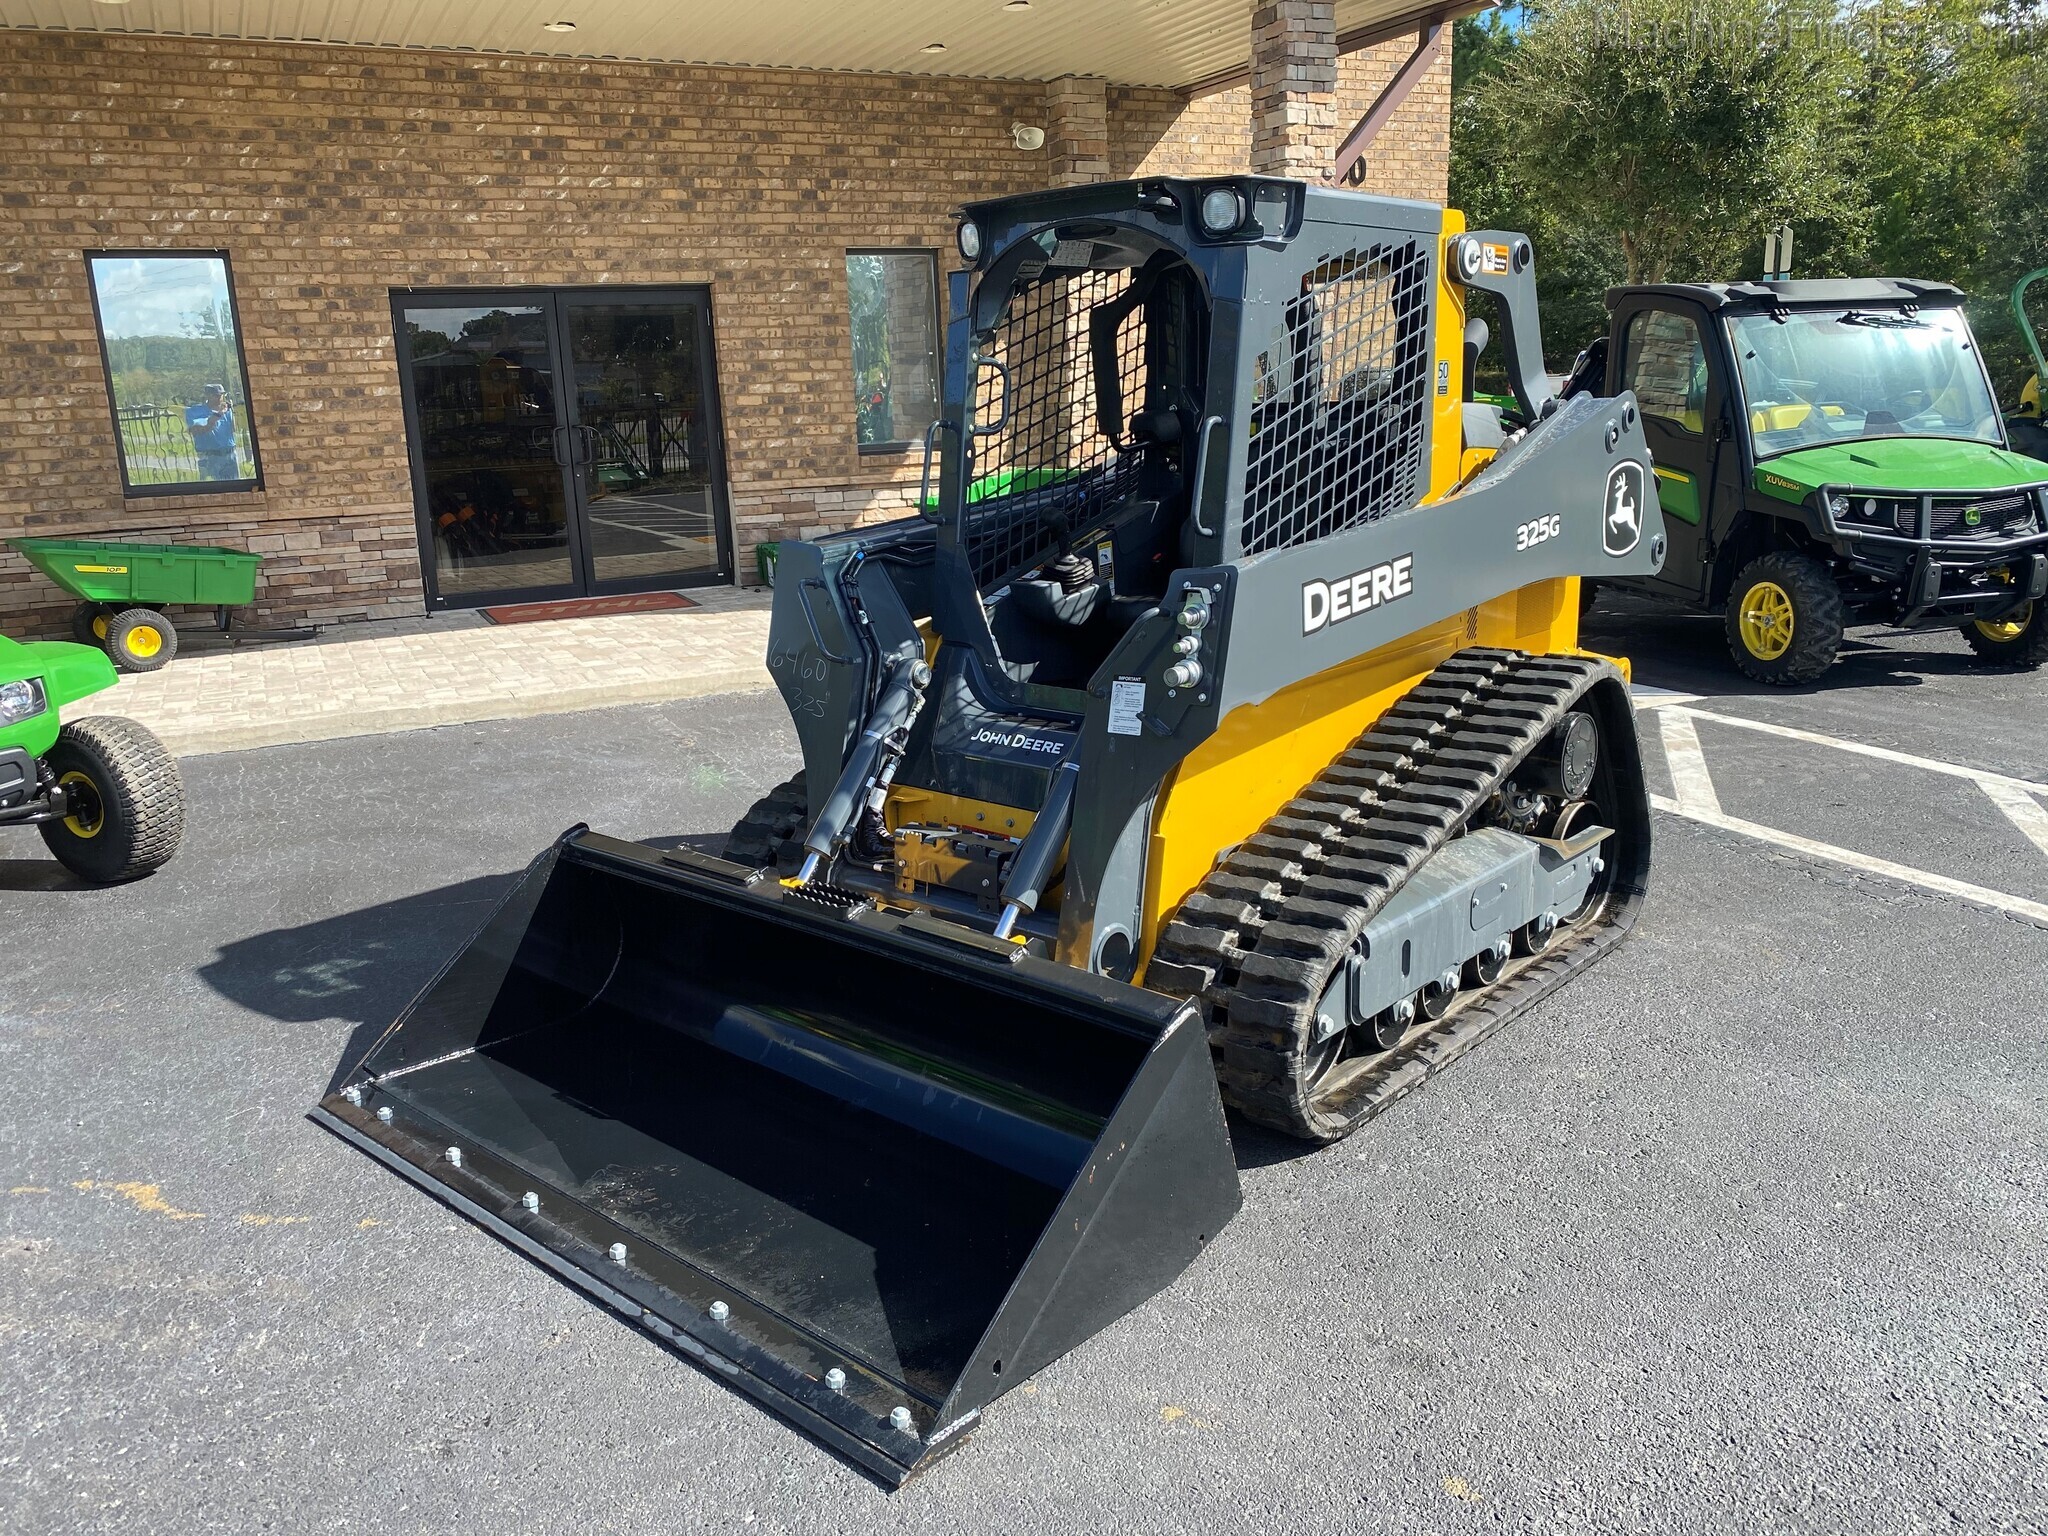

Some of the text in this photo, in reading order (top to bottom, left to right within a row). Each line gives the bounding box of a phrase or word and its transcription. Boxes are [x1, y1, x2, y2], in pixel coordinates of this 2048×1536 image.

[1517, 513, 1561, 552] 325G
[507, 598, 667, 618] STIHL
[1303, 554, 1413, 636] DEERE
[769, 639, 827, 682] 6460
[971, 728, 1064, 754] JOHN DEERE
